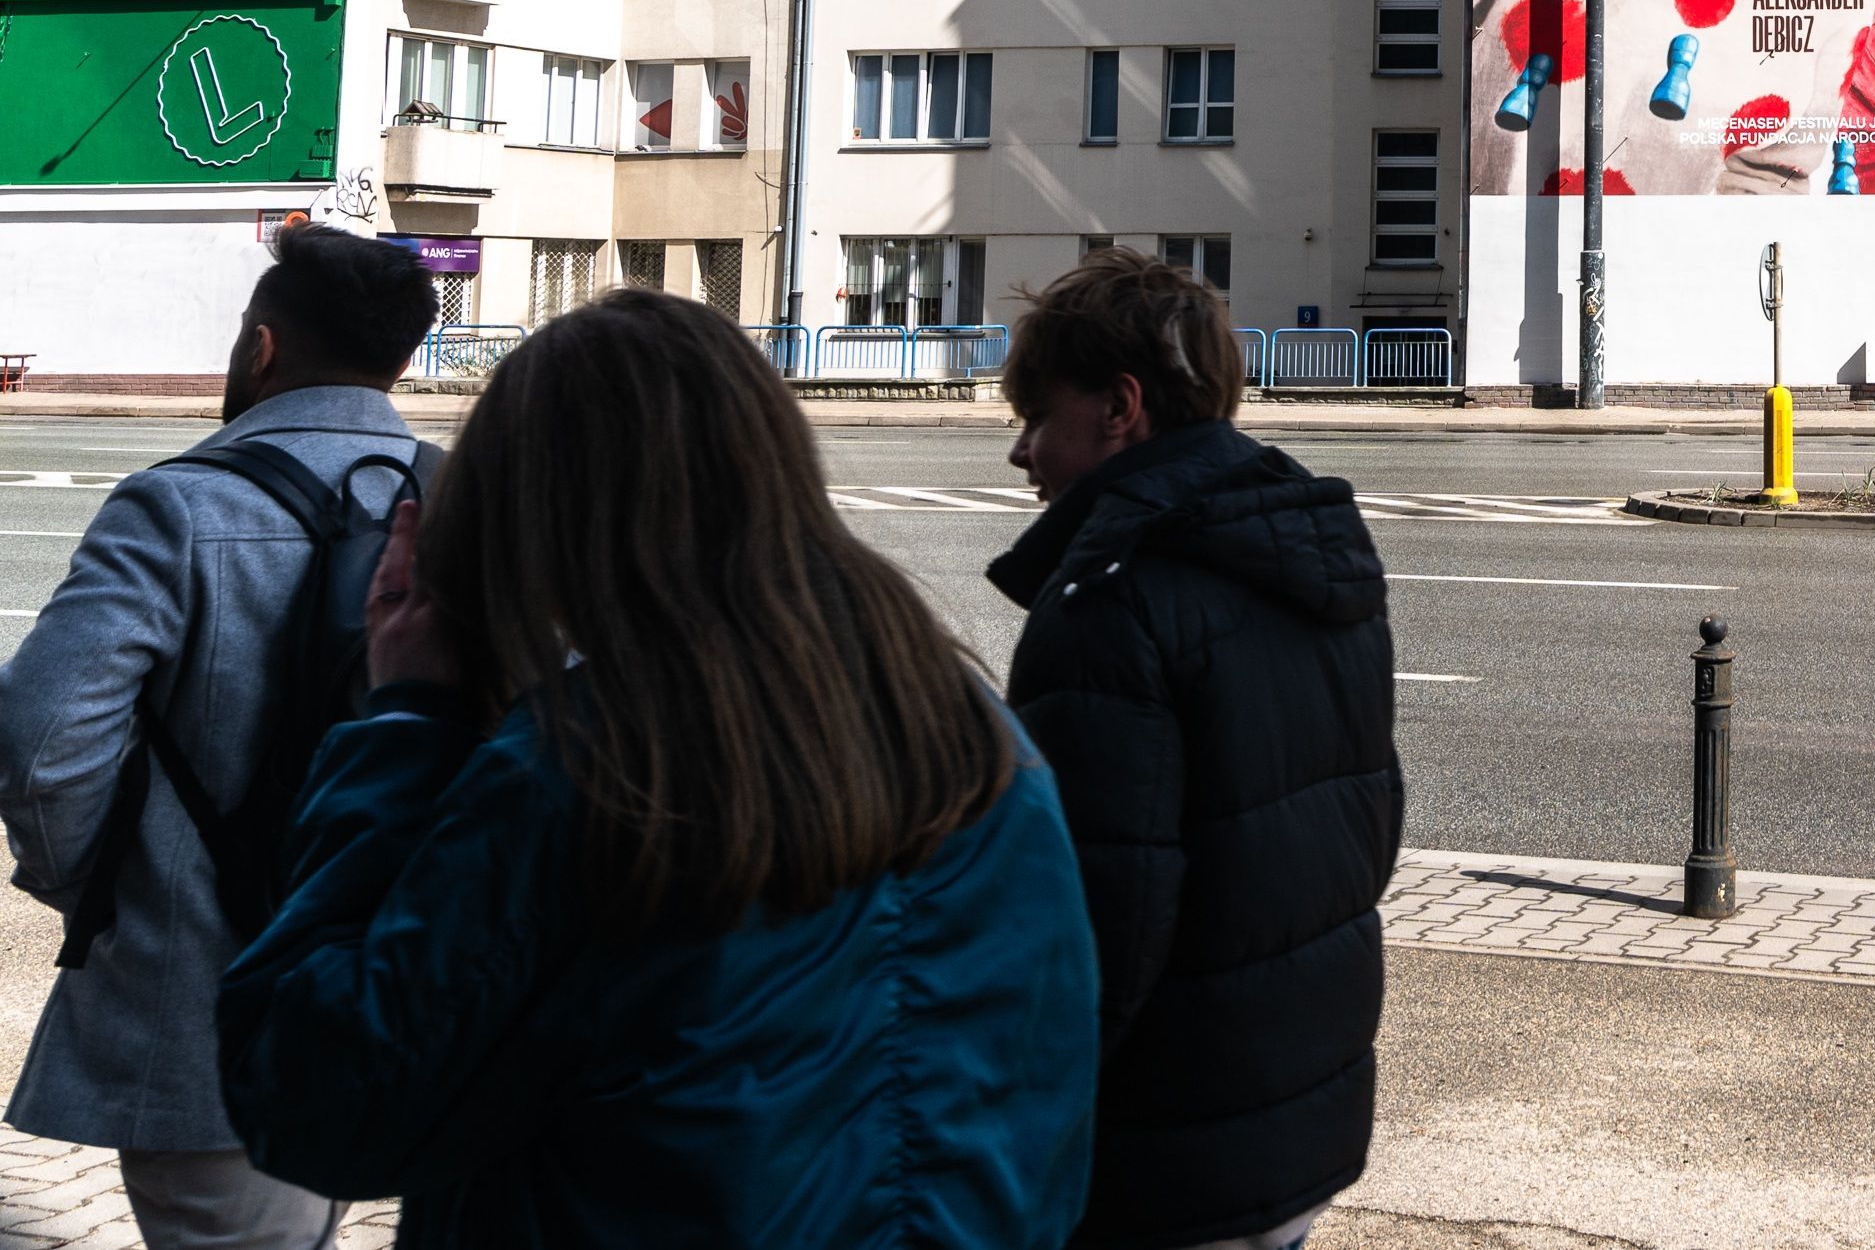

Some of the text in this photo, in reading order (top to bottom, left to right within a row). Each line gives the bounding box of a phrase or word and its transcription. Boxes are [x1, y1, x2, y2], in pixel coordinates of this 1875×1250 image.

[1752, 15, 1814, 59] DĘBICZ
[1697, 116, 1787, 130] MECENASEM
[1790, 116, 1866, 129] FESTIWALU
[1679, 132, 1737, 145] POLSKA
[1739, 132, 1816, 145] FUNDACJA
[429, 247, 451, 259] ANG
[1304, 310, 1312, 323] 9
